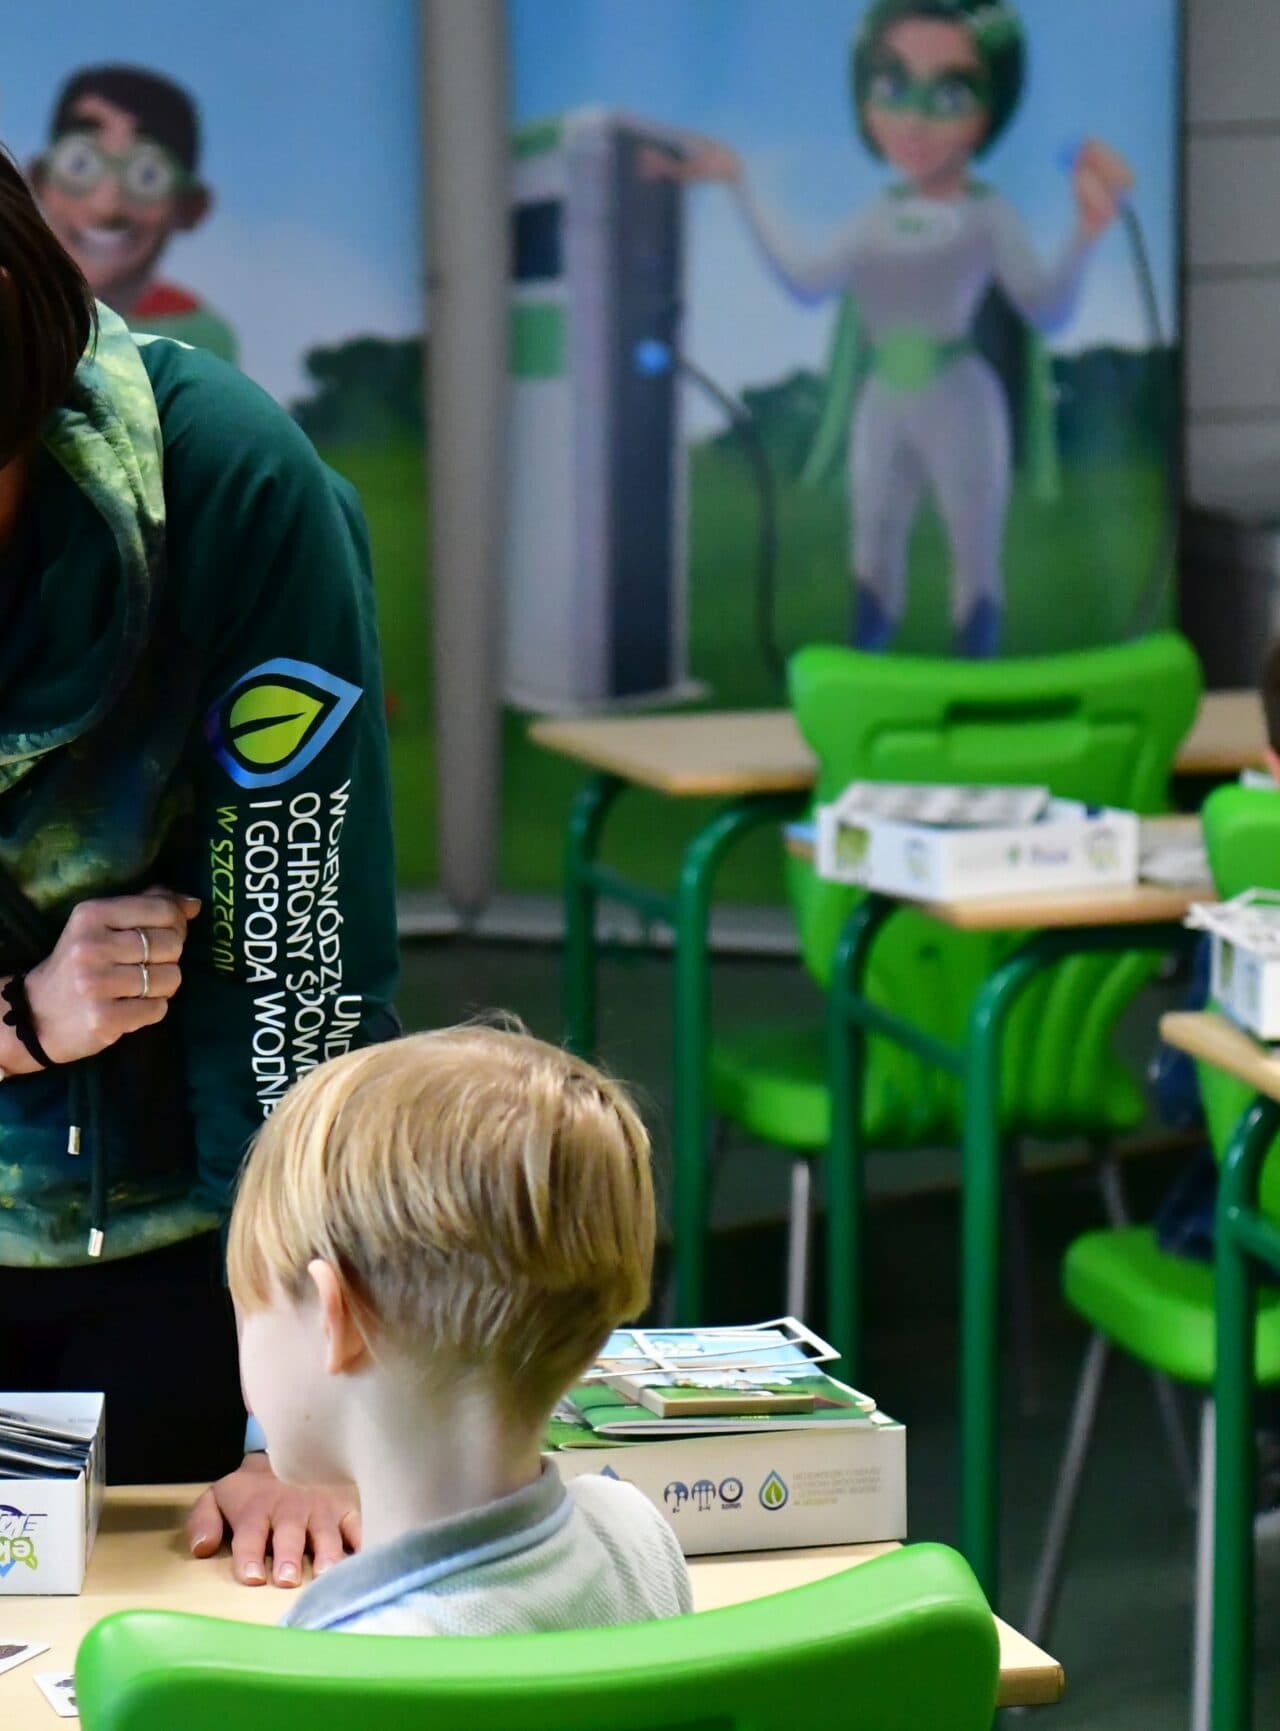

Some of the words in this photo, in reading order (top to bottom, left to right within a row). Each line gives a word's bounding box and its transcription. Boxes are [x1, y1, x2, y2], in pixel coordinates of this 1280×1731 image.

[249, 800, 283, 808] I
[286, 792, 321, 961] OCHRONY
[210, 839, 235, 972] SZCZECINI
[243, 820, 280, 983] GOSPODA
[316, 778, 352, 995] WOJEWÓDZK
[324, 995, 363, 1061] UND
